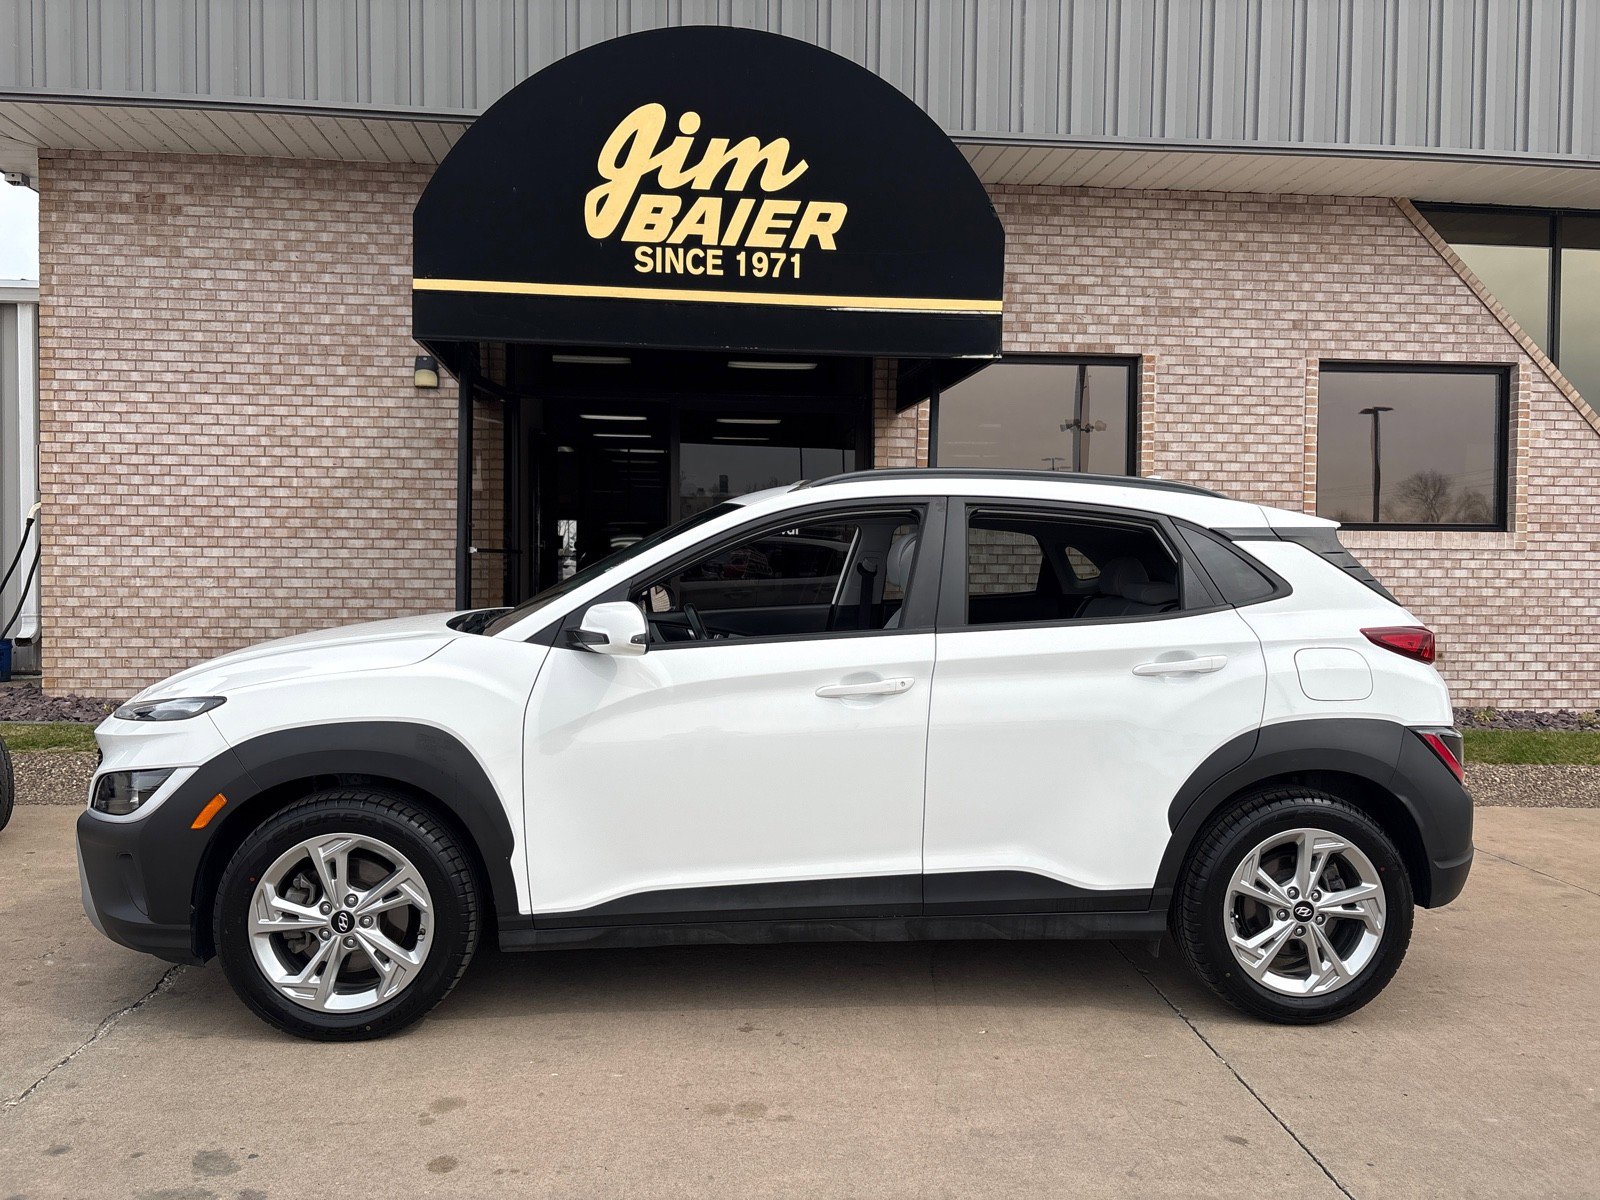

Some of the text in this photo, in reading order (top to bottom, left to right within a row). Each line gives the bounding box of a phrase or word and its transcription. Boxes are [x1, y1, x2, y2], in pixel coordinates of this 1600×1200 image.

[584, 102, 809, 240] Jim
[620, 193, 848, 251] BAIER
[634, 245, 801, 279] SINCE 1971
